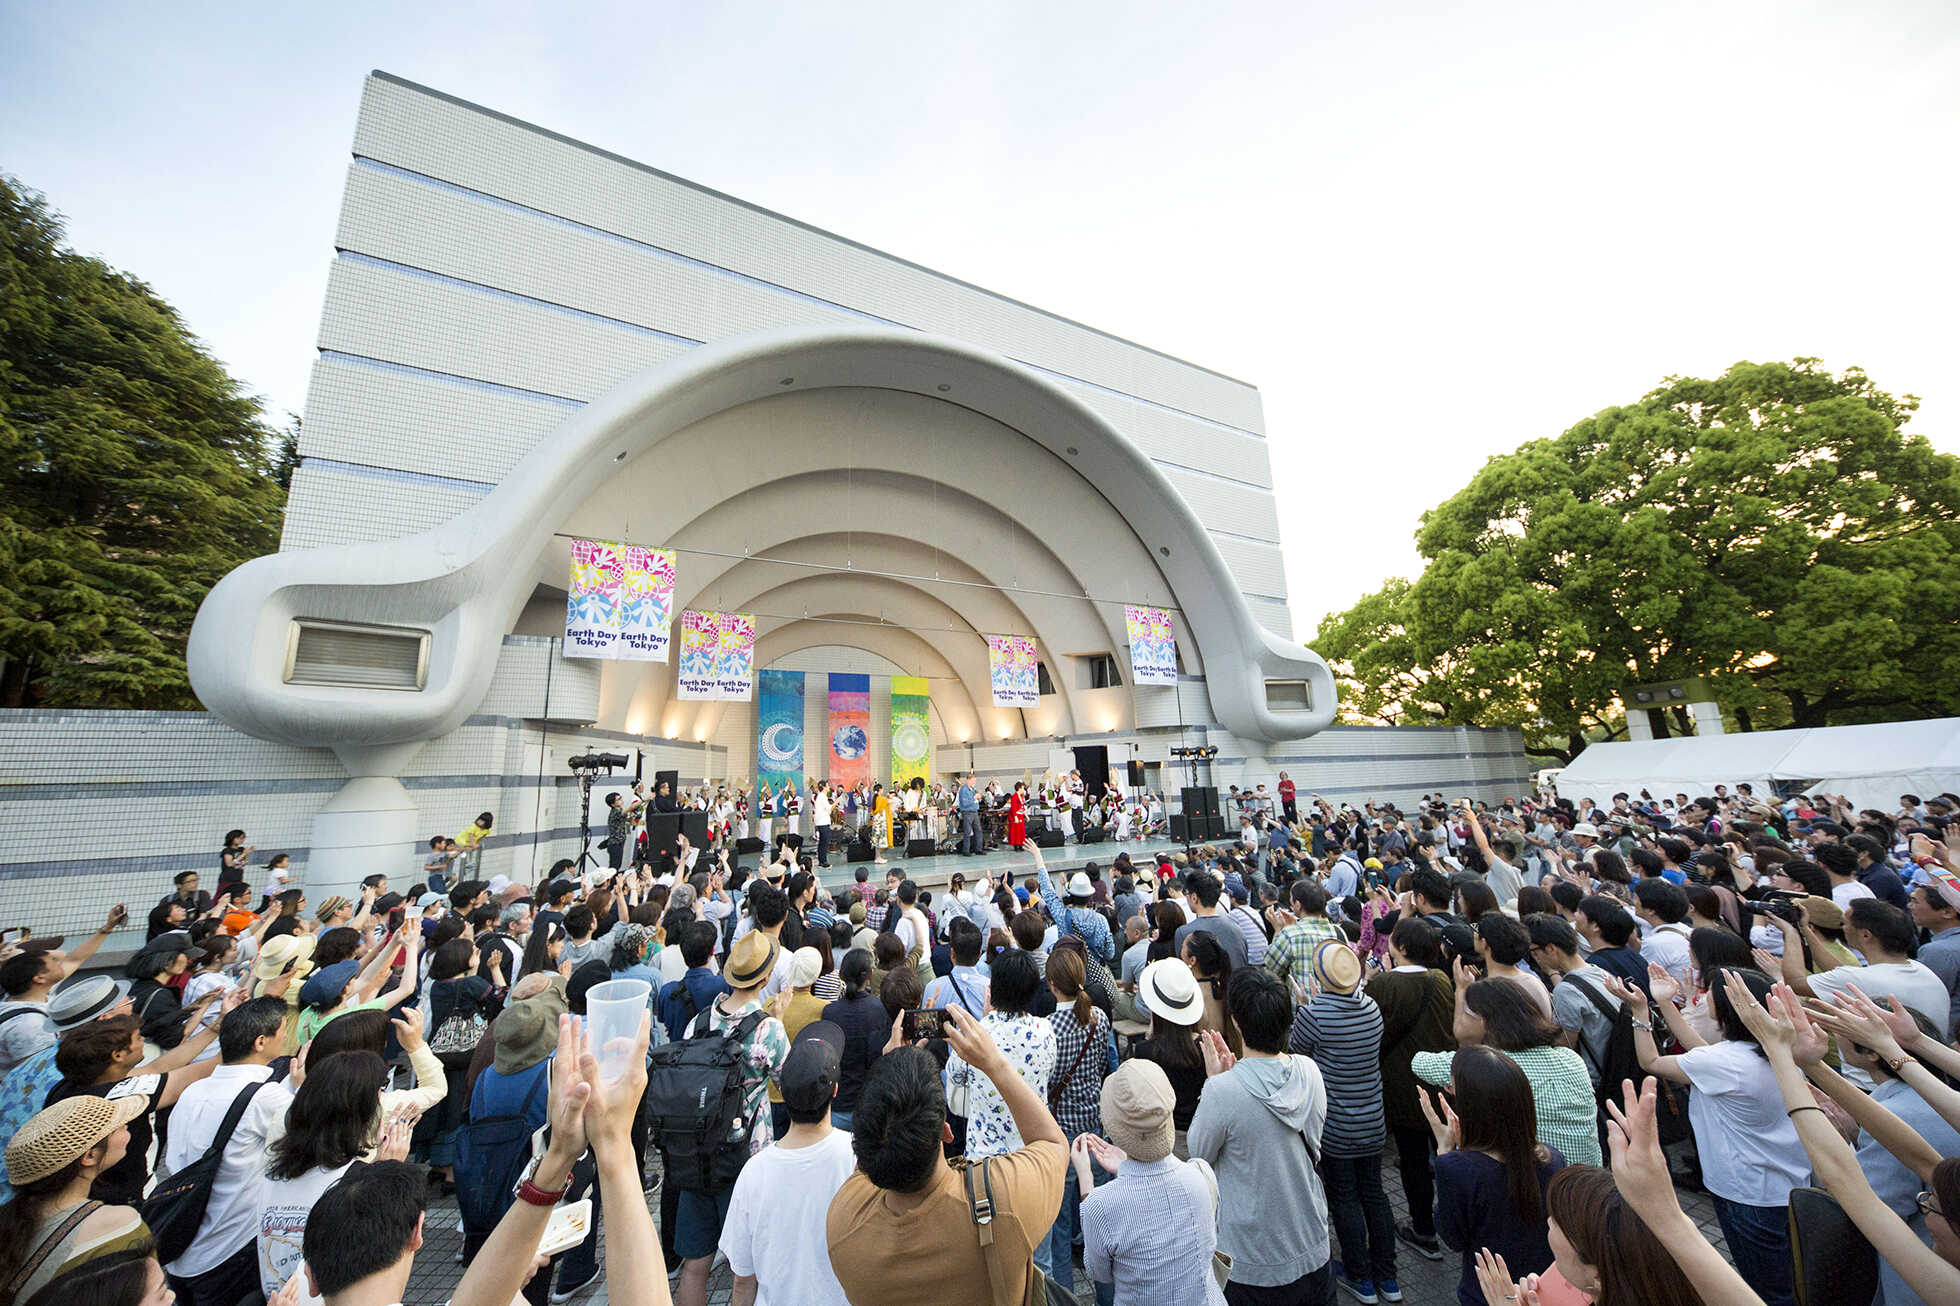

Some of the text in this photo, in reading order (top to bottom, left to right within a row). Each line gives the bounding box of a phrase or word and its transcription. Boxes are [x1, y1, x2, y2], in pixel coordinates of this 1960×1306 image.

[567, 628, 618, 640] Earth Day
[620, 632, 668, 645] Earth Day
[576, 638, 607, 648] Tokyo
[630, 641, 658, 650] Tokyo
